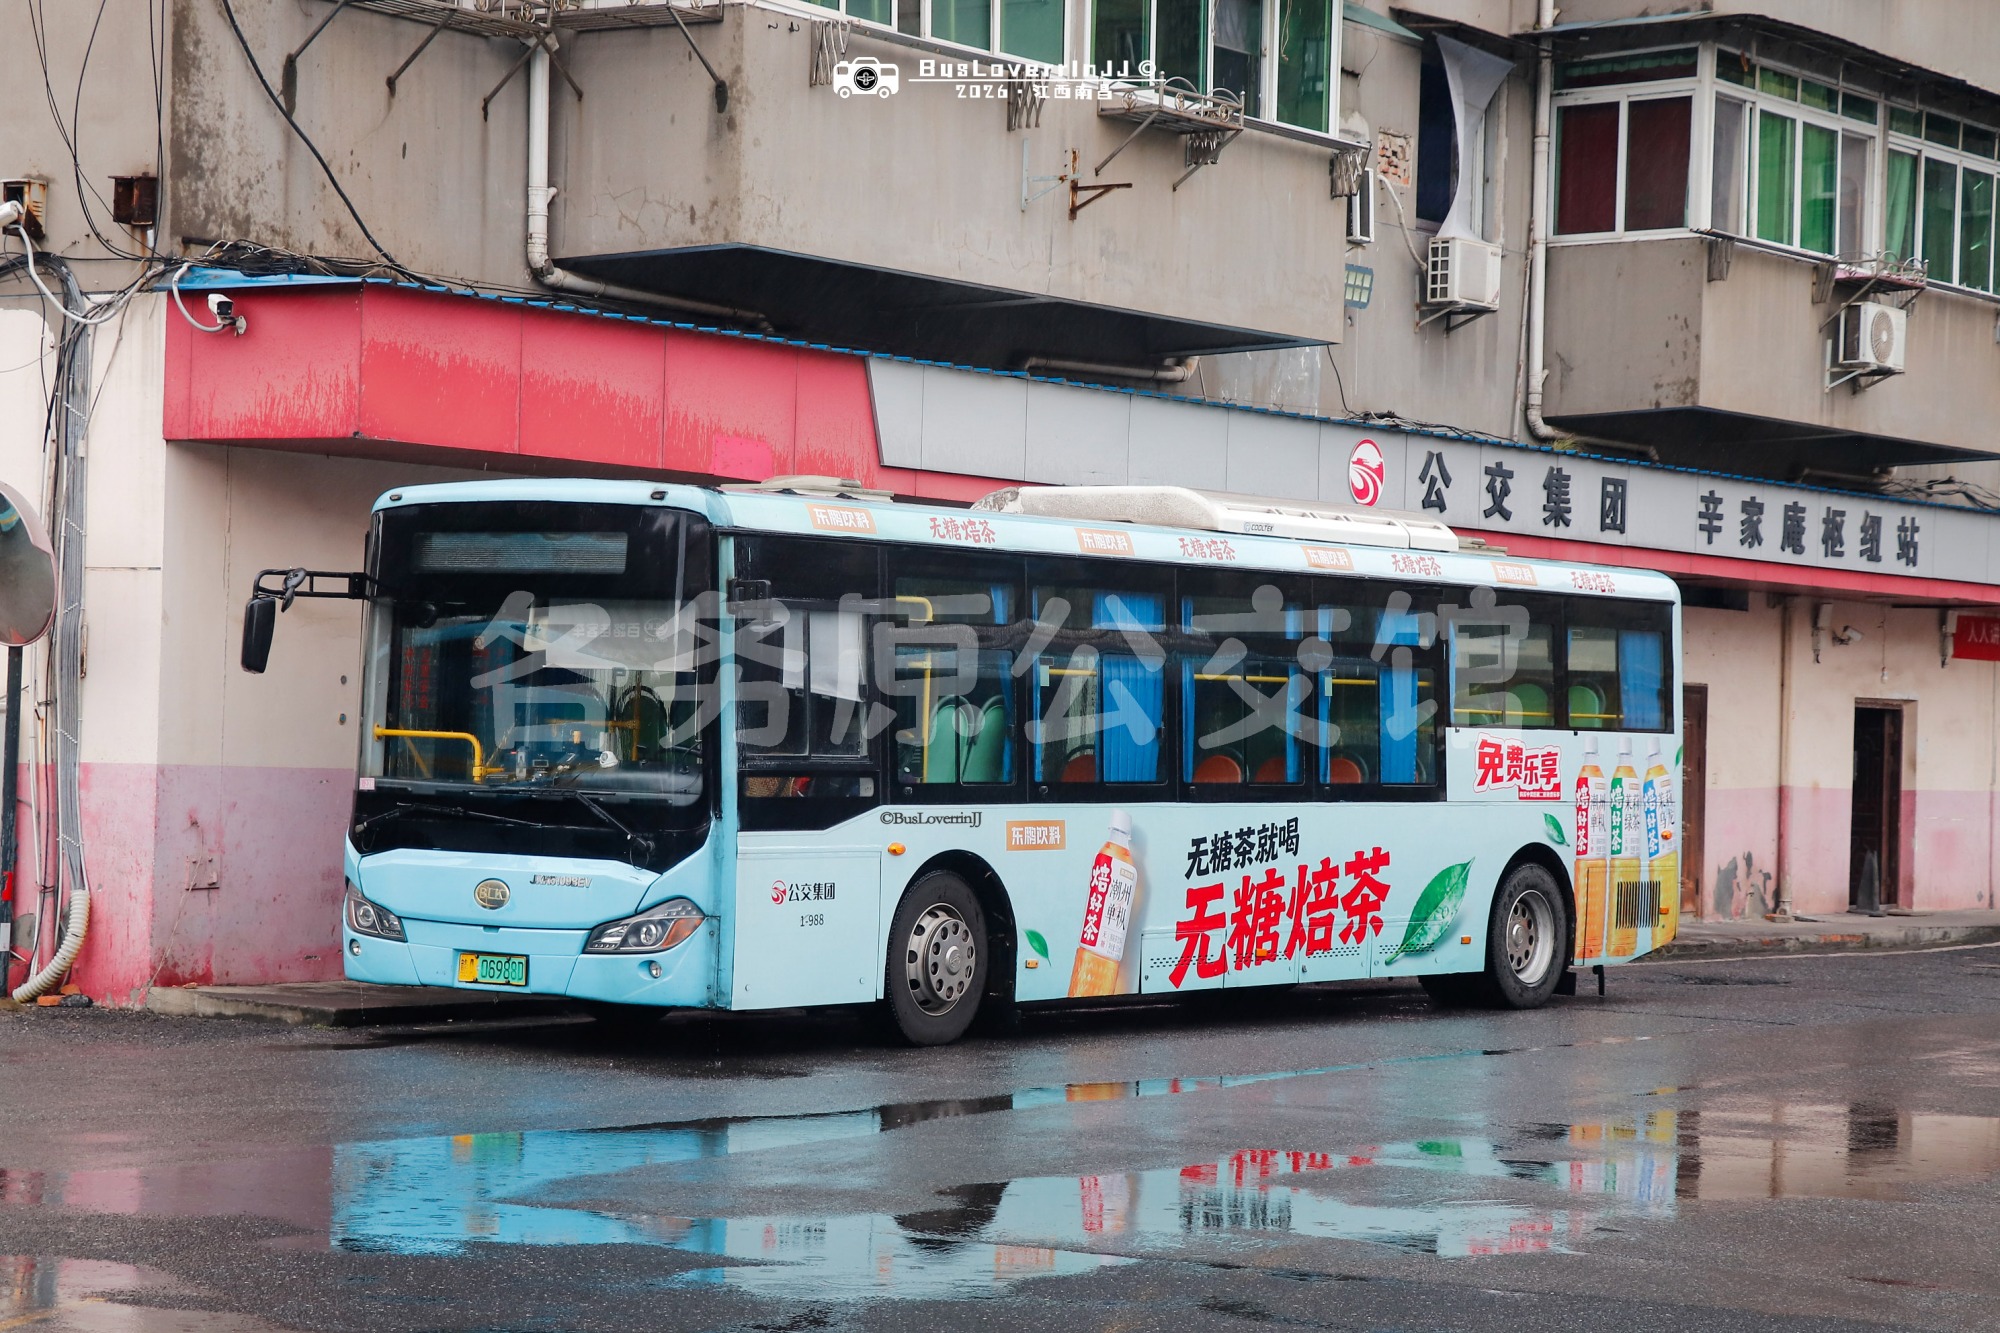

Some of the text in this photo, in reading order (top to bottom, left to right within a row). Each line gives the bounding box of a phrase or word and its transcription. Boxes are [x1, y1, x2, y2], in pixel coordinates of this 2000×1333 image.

[929, 517, 996, 544] 无糖焙茶
[1418, 450, 1920, 568] 公交集团 辛家庵枢纽站
[1179, 537, 1237, 561] 无糖焙茶
[1477, 740, 1558, 786] 免费乐享
[1011, 826, 1061, 846] 东鹏饮料
[1184, 817, 1300, 880] 无糖茶就喝
[1576, 784, 1590, 852] 焙好茶
[1611, 784, 1624, 851] 焙好茶
[1643, 787, 1659, 853] 焙好茶
[788, 881, 836, 902] 公交集团
[1084, 863, 1110, 940] 焙好茶
[1169, 847, 1391, 989] 无糖焙茶
